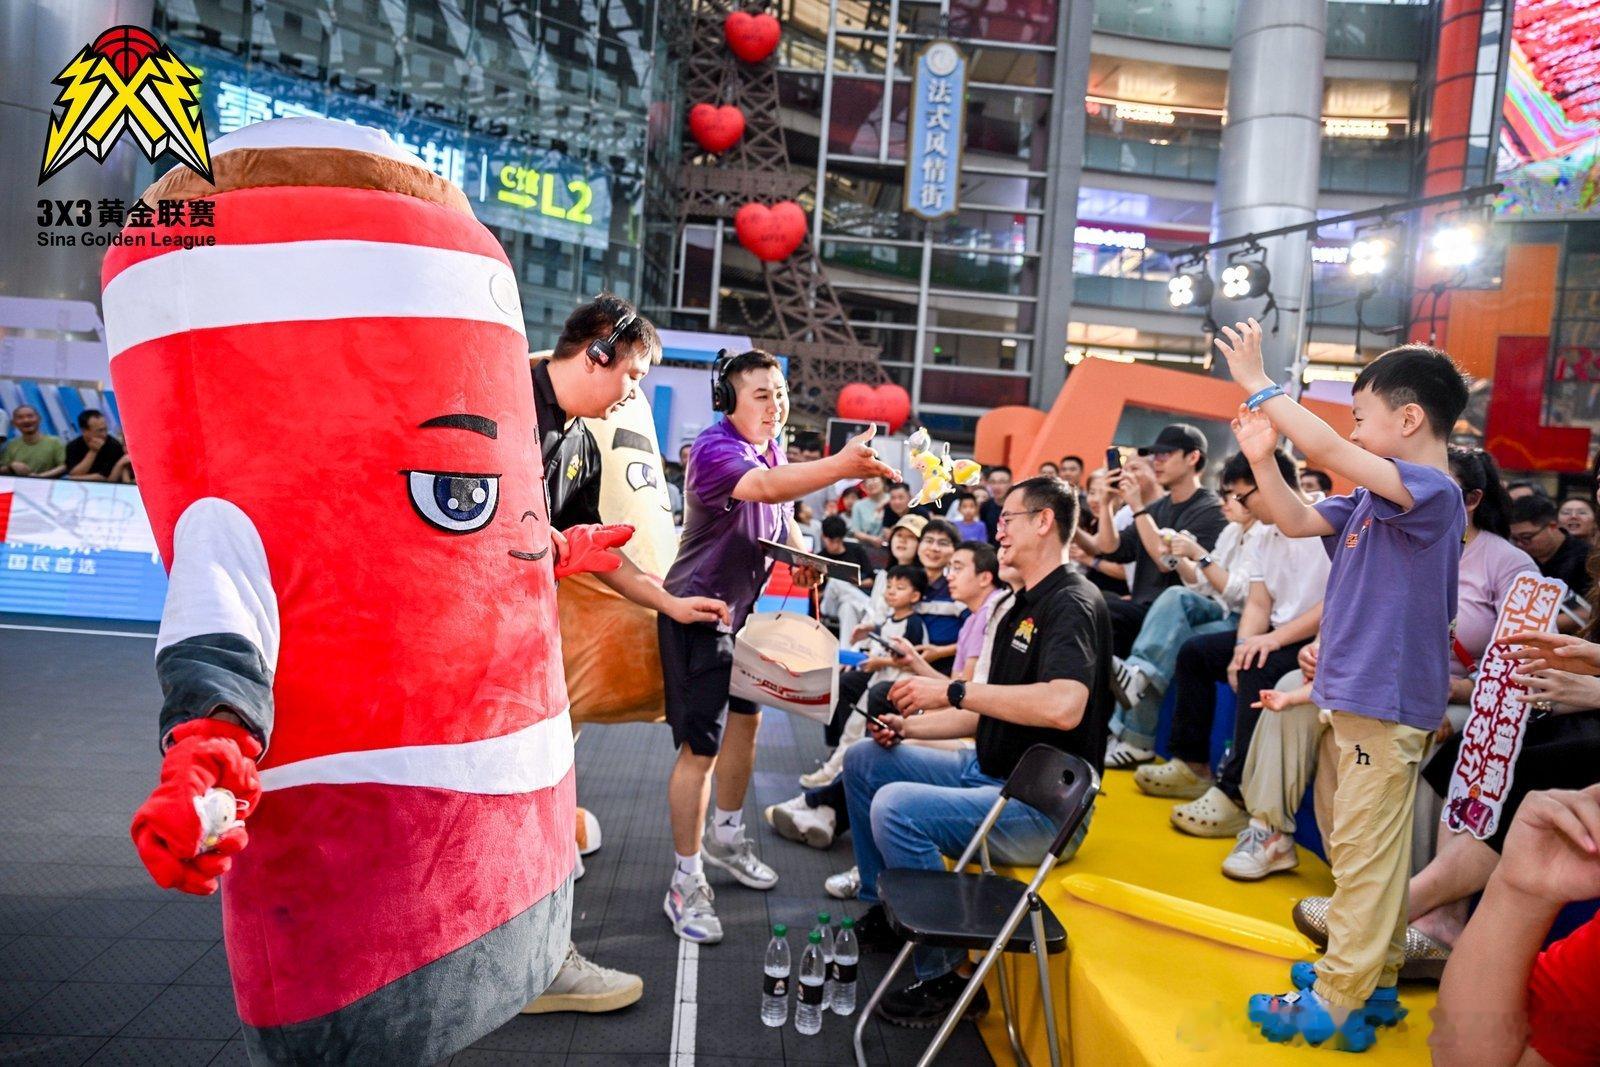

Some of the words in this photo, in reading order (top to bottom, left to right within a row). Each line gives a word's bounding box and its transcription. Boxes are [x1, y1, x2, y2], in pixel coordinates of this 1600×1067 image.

[921, 79, 952, 209] 法式风情街
[541, 172, 593, 224] L2
[7, 554, 96, 574] 国民首选
